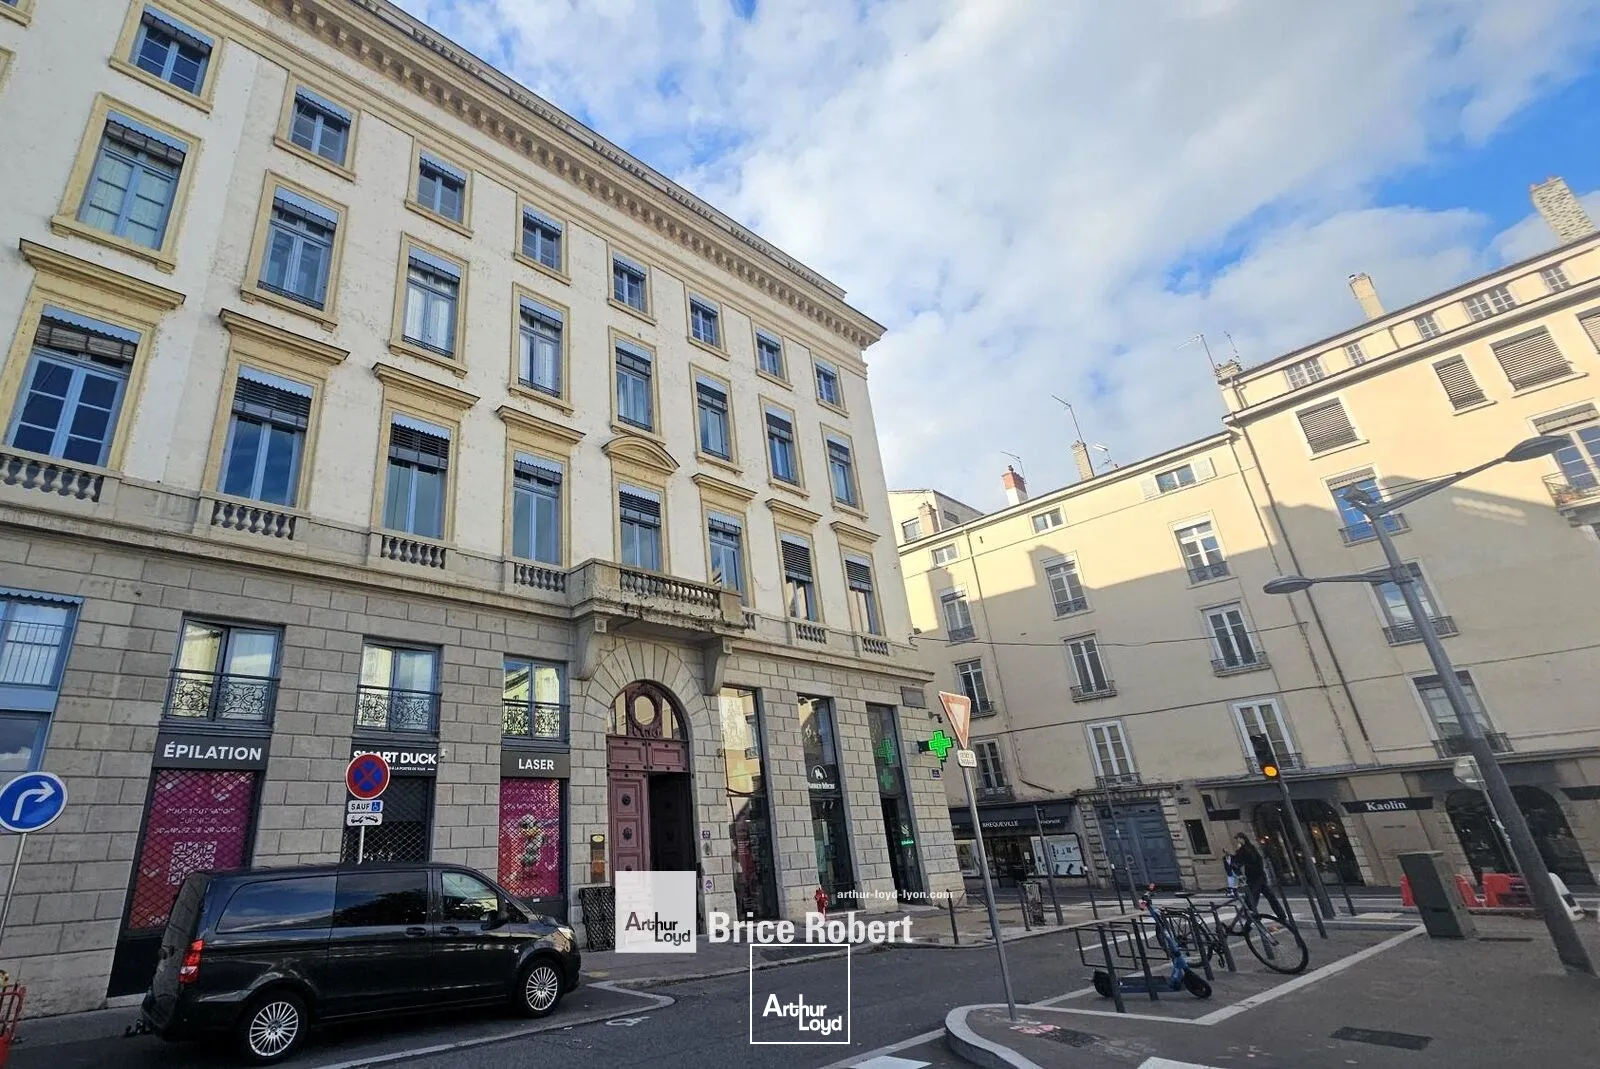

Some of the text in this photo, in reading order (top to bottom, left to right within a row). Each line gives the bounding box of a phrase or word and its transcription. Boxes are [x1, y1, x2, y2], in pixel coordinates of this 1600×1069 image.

[163, 741, 262, 761] ÉPILATION
[400, 752, 437, 765] DUCK
[518, 758, 555, 771] LASER
[351, 803, 370, 811] SAUF
[1365, 800, 1407, 811] Kaolin
